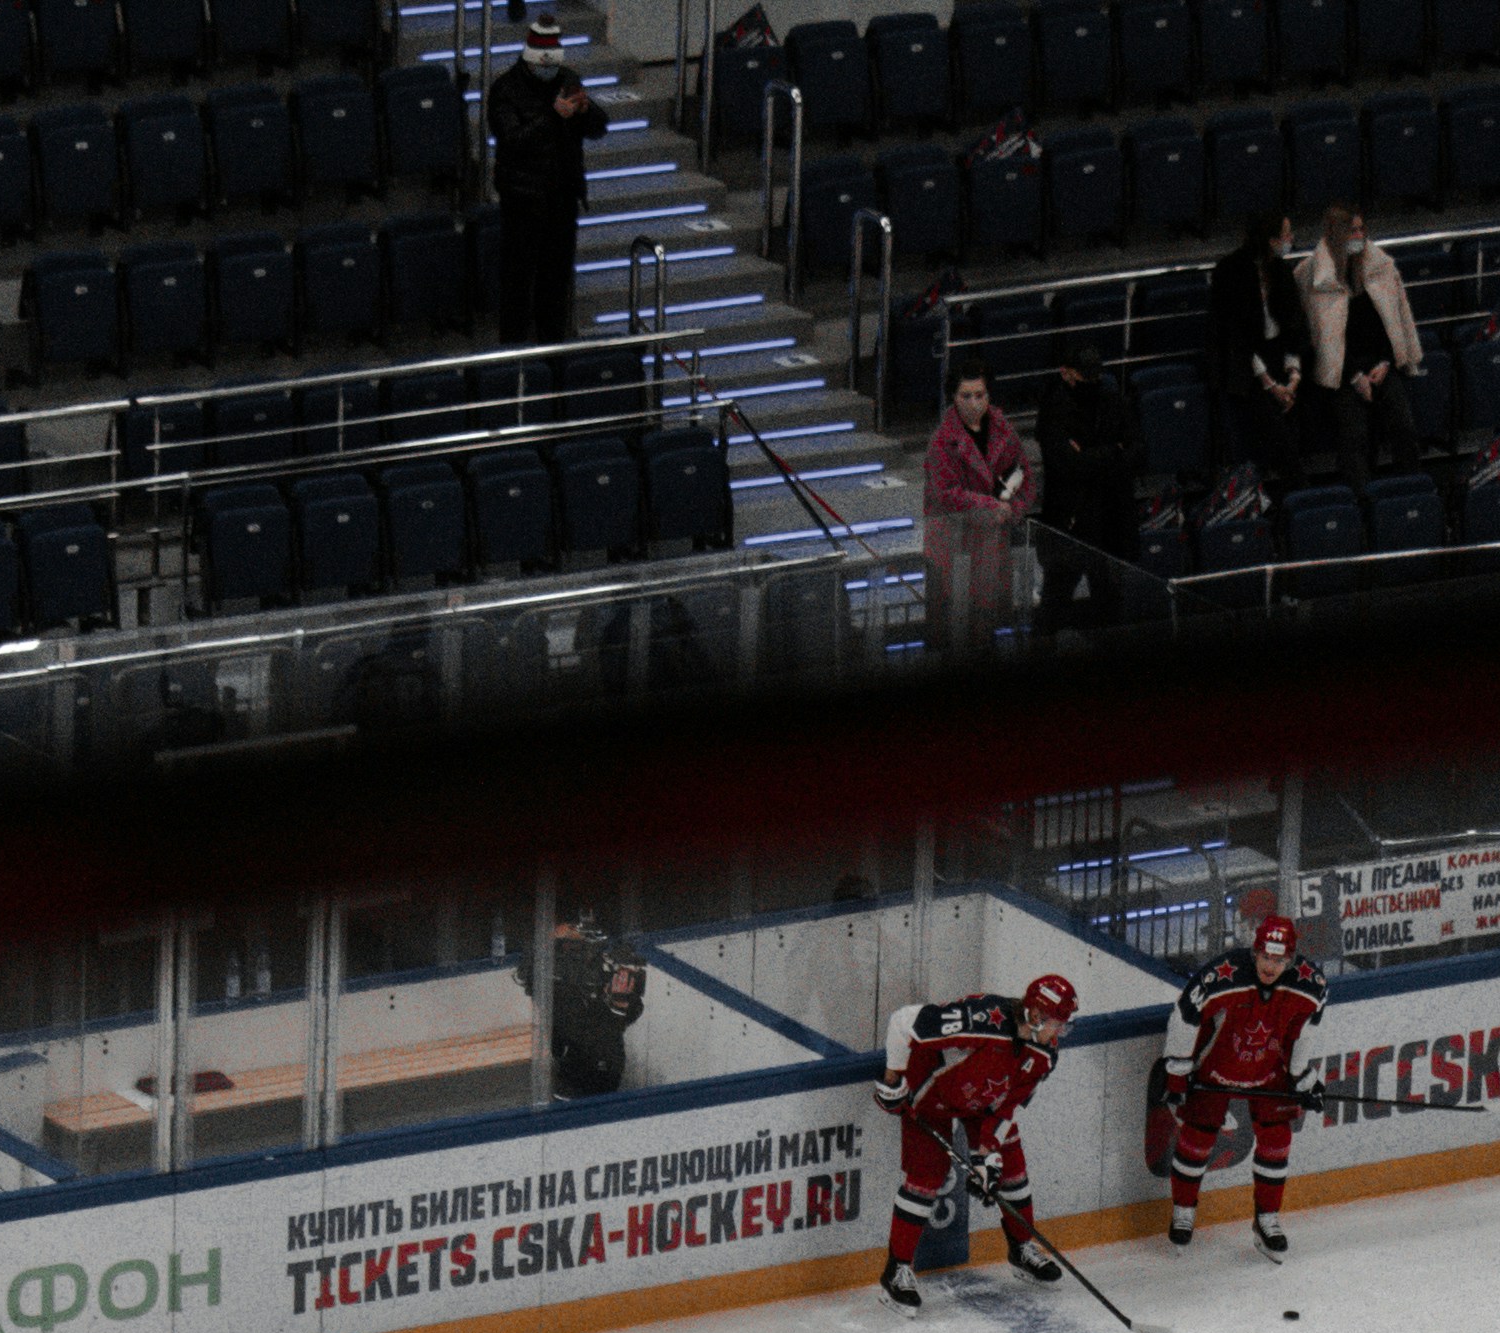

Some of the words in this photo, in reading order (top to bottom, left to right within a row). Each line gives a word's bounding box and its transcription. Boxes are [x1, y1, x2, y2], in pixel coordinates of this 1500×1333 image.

[1342, 885, 1441, 921] ДИНСТВЕННОЙ
[1344, 919, 1414, 951] ОМАНДЕ
[287, 1189, 404, 1250] КУПИТЬ
[410, 1177, 532, 1230] БИЛЕТЫ
[538, 1170, 578, 1208] НА
[584, 1129, 773, 1200] СЛЕДУЮЩИЙ
[778, 1123, 863, 1171] МАТЧ:
[286, 1169, 862, 1315] TICKETS.CSKA-HOCKEY.RU
